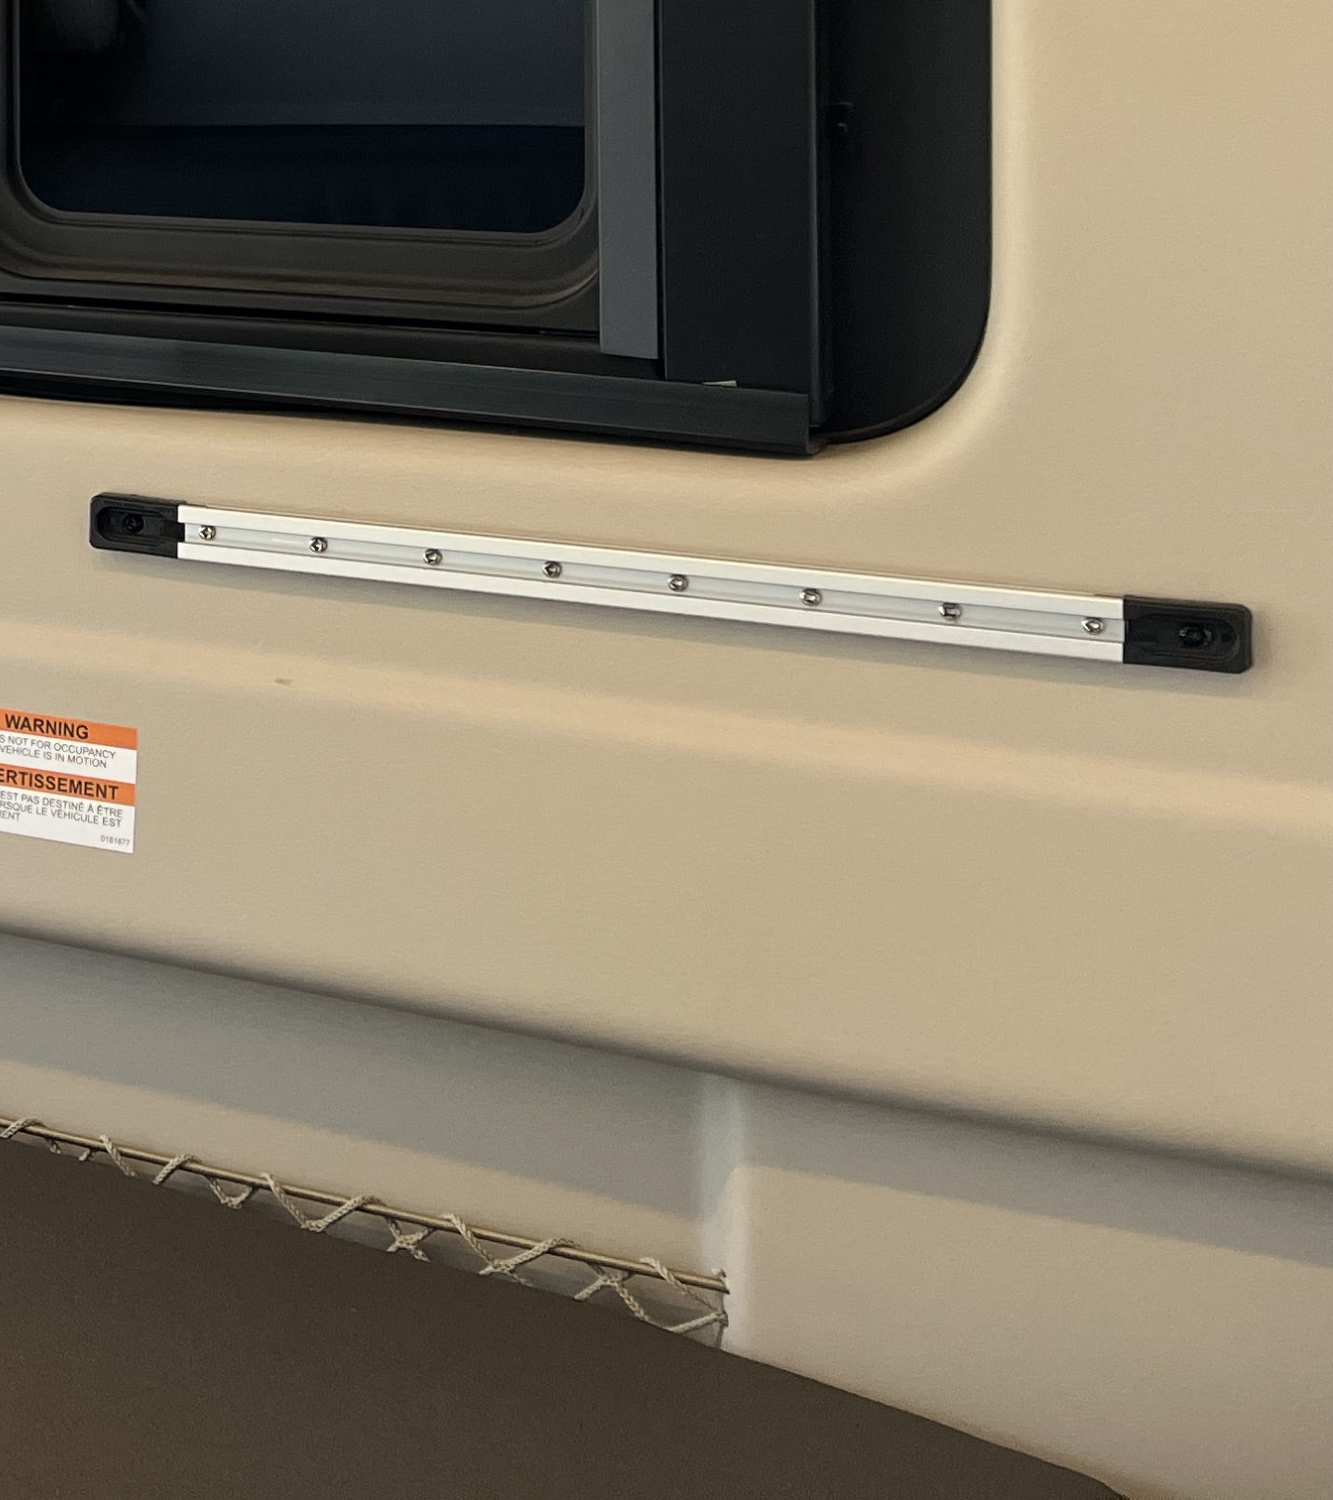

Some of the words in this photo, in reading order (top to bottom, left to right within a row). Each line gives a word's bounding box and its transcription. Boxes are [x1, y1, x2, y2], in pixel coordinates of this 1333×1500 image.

[5, 713, 89, 740] WARNING
[0, 743, 40, 758] VEHICLE
[43, 751, 52, 760] IS
[55, 753, 65, 763] IN
[68, 754, 107, 769] MOTION
[8, 735, 29, 746] NOT
[30, 739, 51, 750] FOR
[53, 742, 116, 759] OCCUPANCY
[21, 793, 40, 805] PAS
[36, 806, 48, 817] LE
[102, 816, 122, 828] EST
